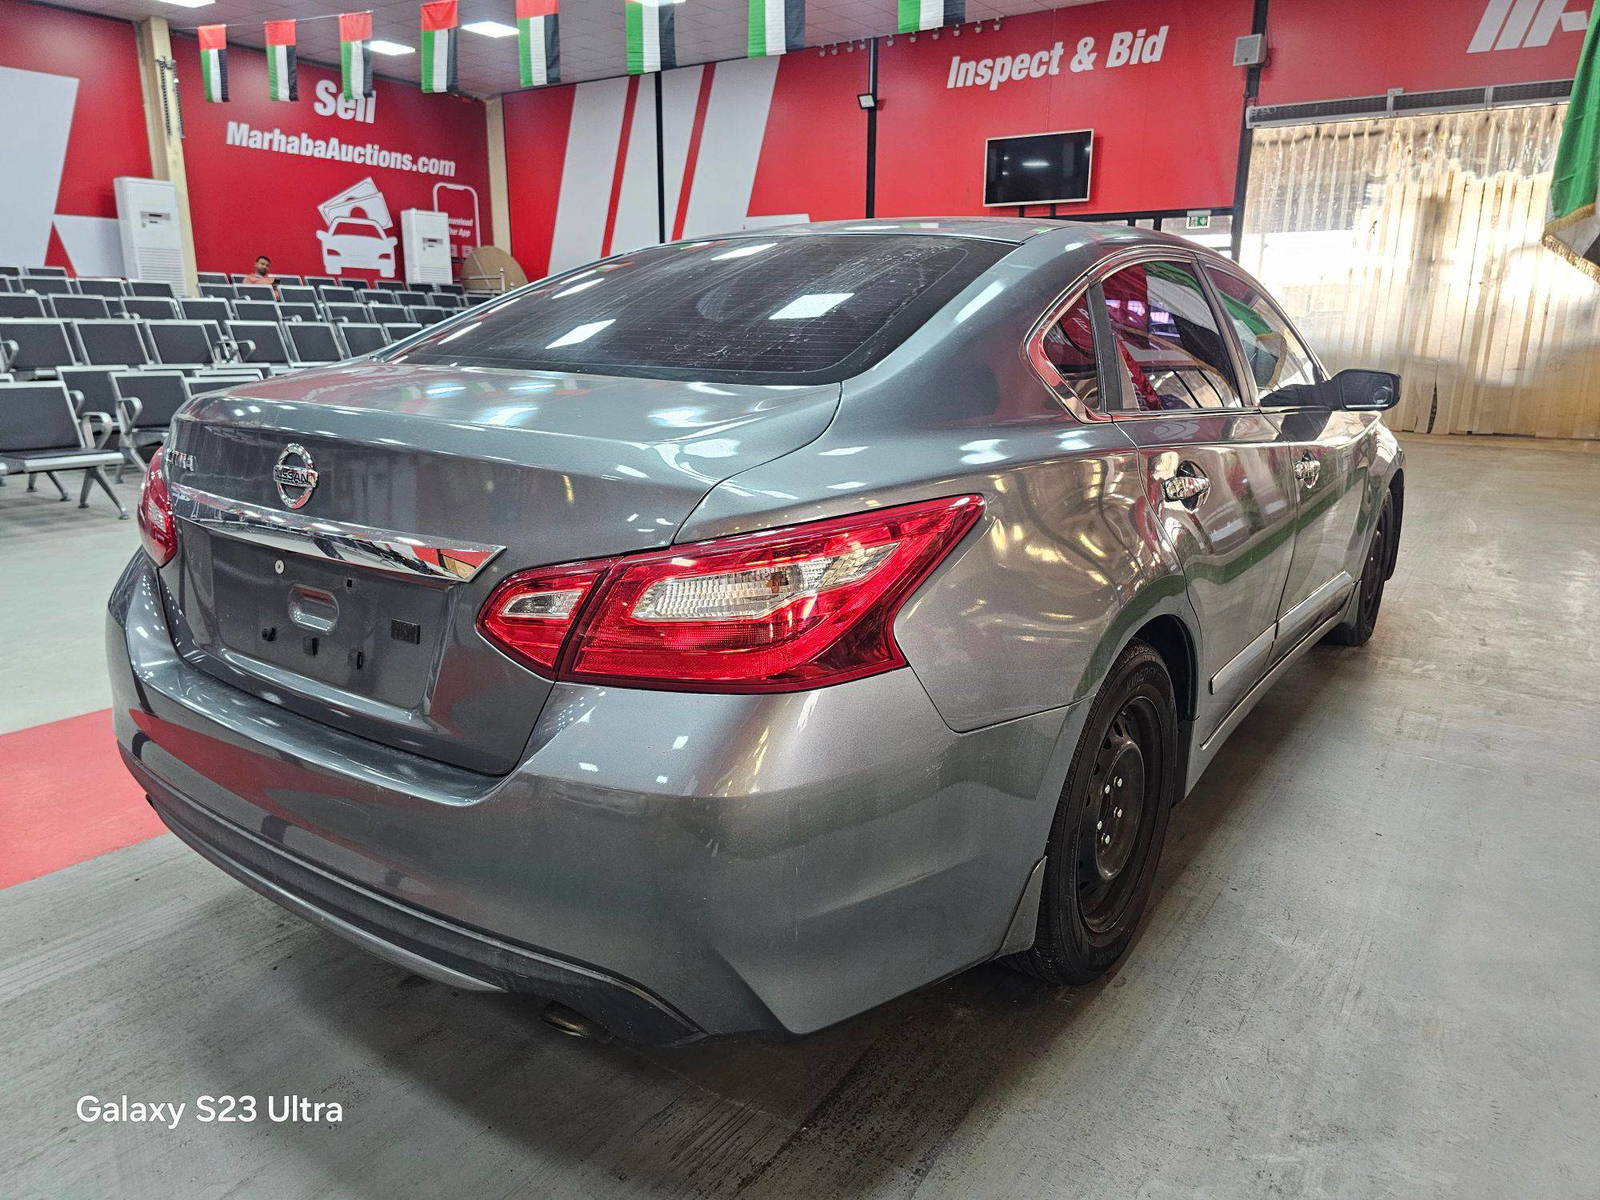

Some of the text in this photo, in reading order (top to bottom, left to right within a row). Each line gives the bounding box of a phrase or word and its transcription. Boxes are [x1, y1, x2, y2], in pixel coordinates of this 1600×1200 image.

[947, 25, 1170, 91] Inspect & Bid
[313, 79, 376, 123] Sell
[226, 121, 456, 177] MarhabaAuctions.com
